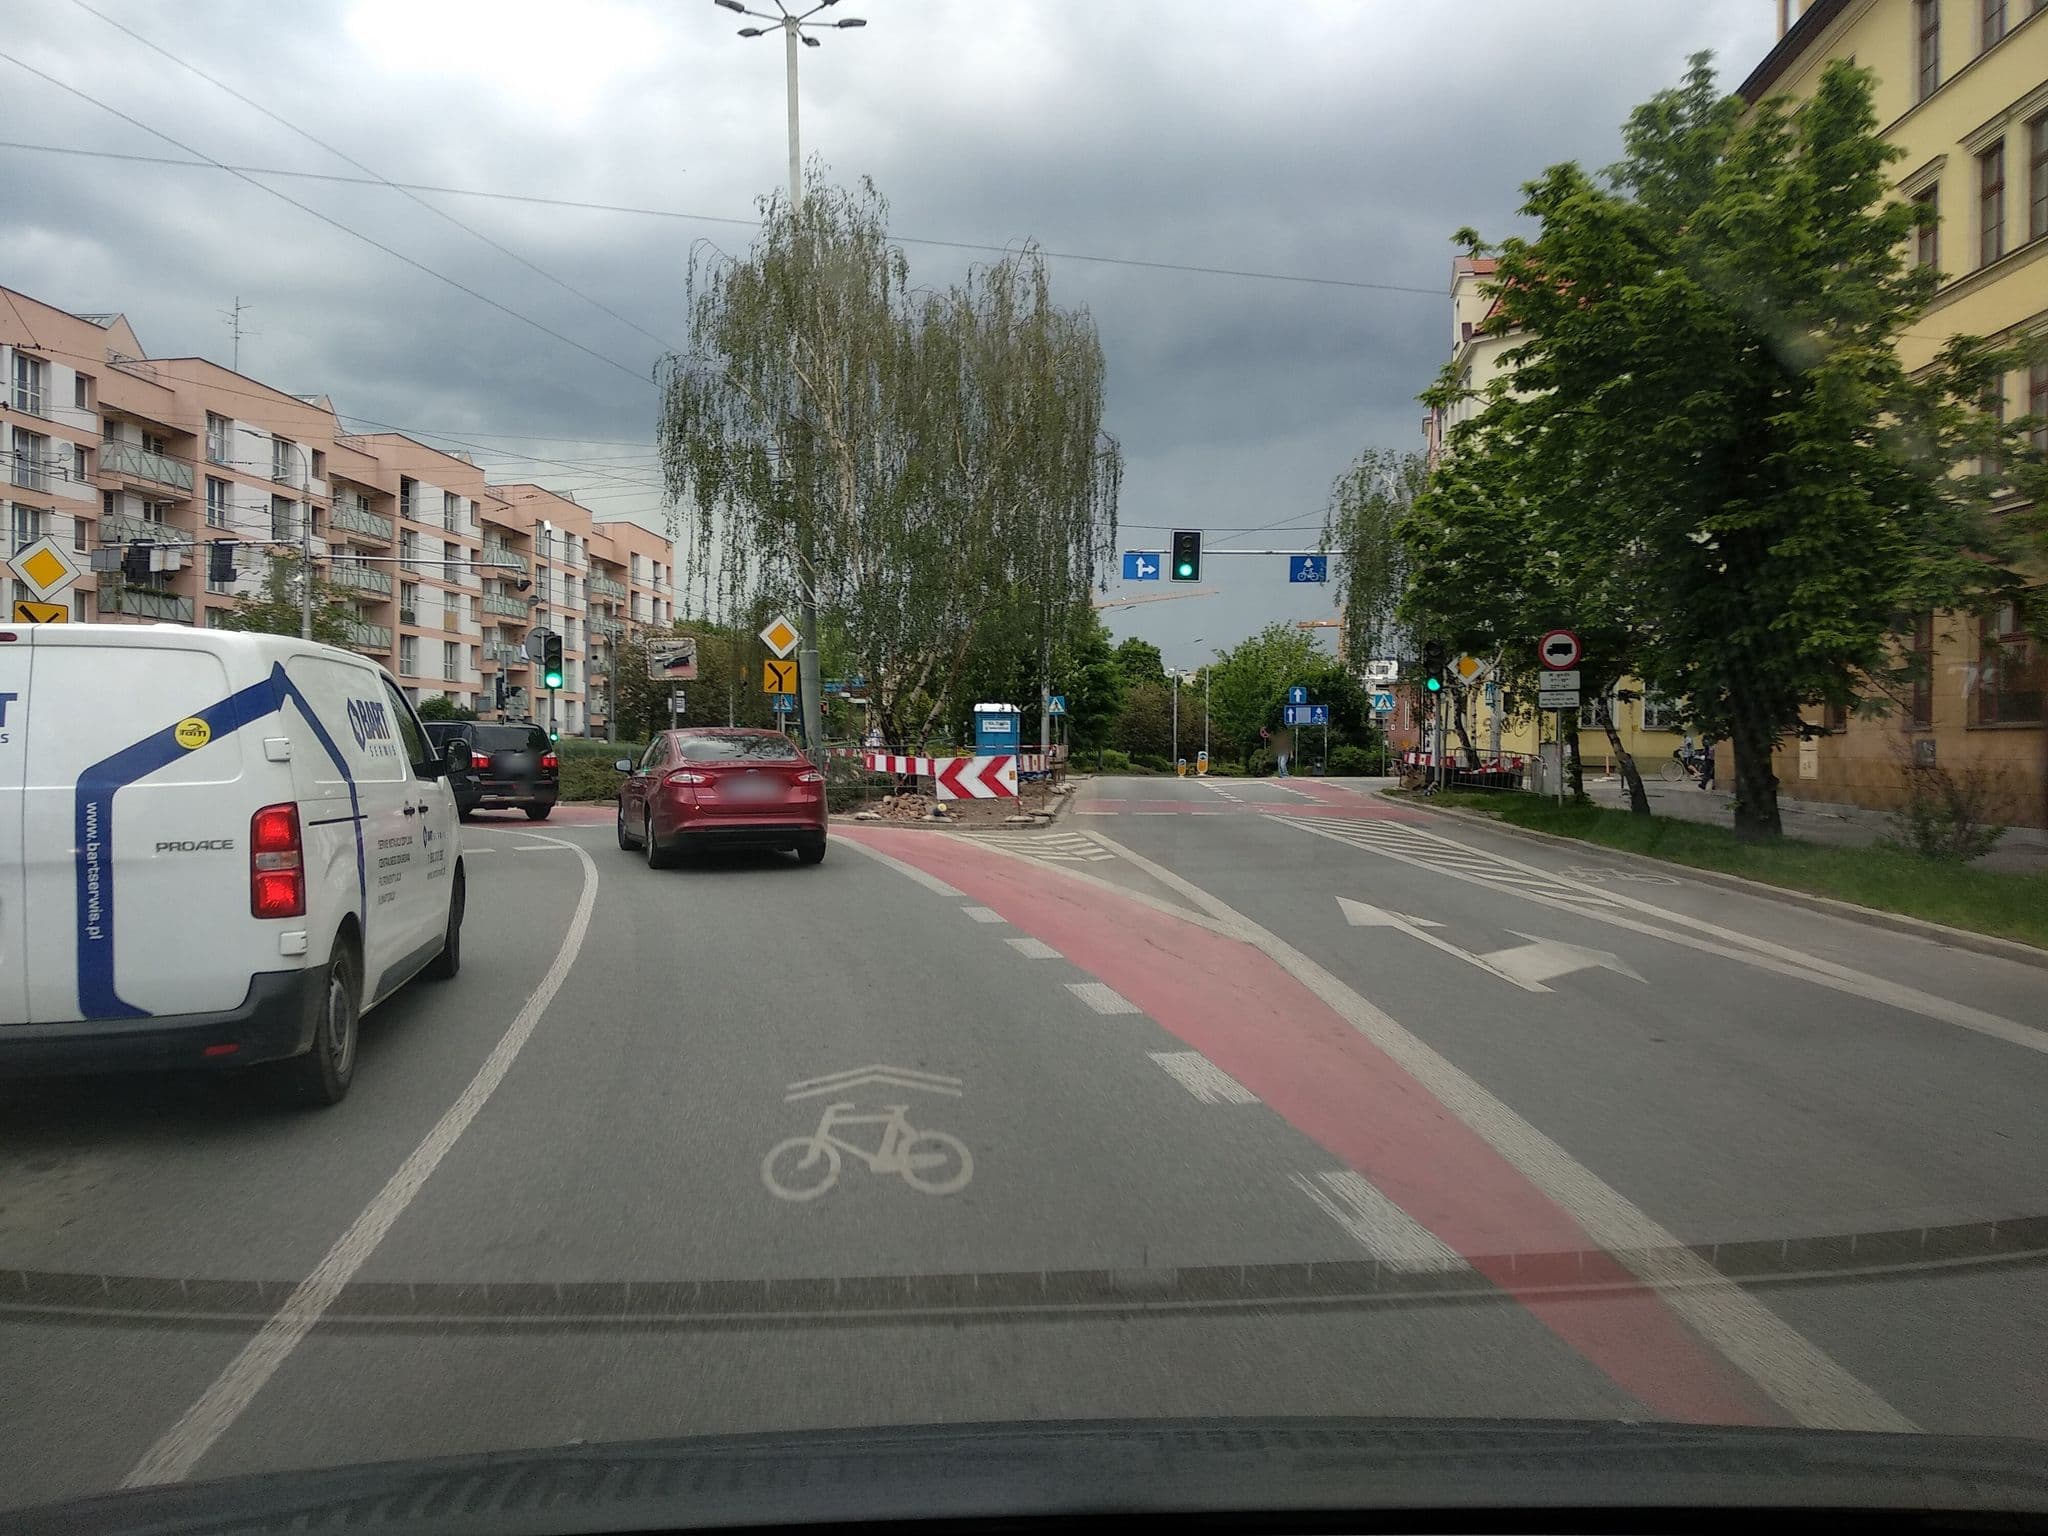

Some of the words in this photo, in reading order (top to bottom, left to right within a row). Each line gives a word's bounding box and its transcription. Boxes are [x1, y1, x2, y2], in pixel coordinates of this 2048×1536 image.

[356, 699, 390, 739] BART
[156, 839, 234, 853] PROACE
[86, 801, 104, 940] www.bartserwis.pl
